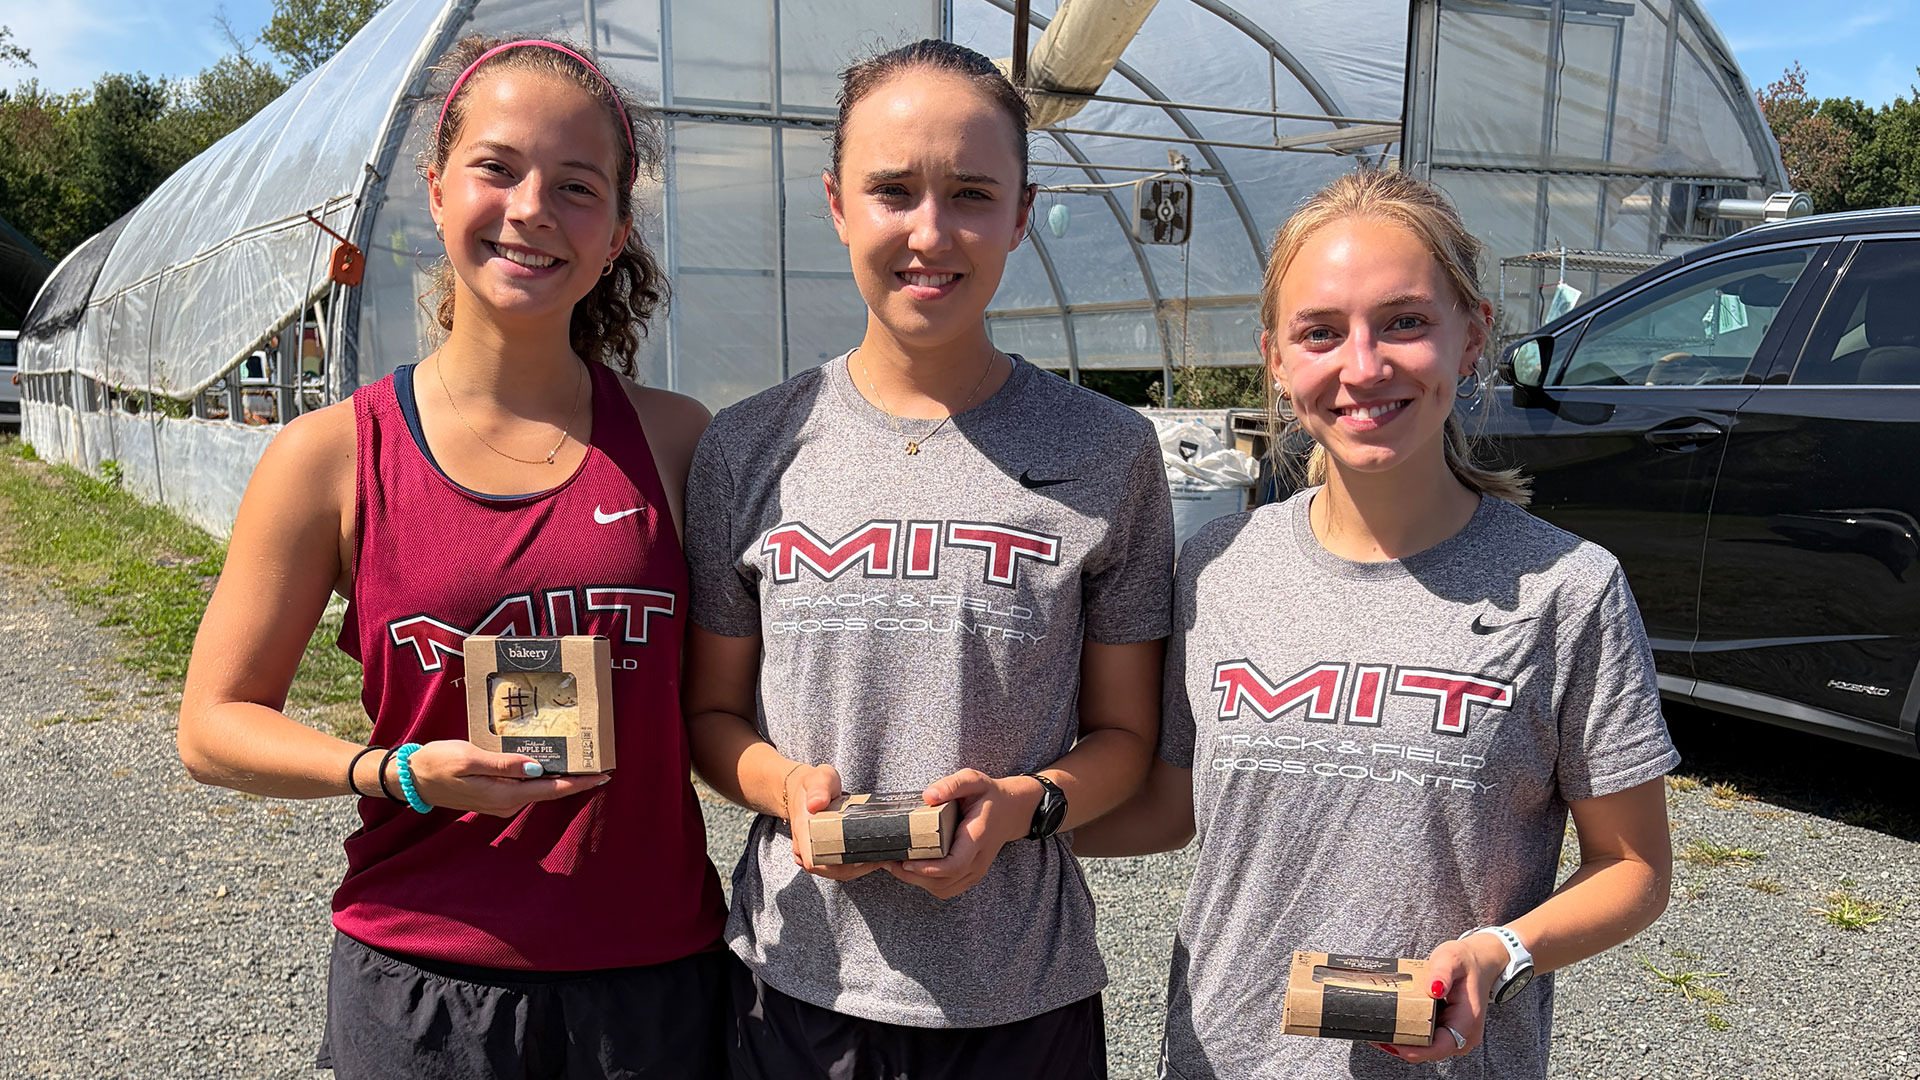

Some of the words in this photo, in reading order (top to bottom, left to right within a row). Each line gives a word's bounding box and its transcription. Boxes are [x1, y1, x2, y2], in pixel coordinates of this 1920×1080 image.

[760, 519, 1062, 589] MIT
[776, 593, 889, 611] TRACK
[896, 594, 923, 608] &
[930, 595, 1033, 620] FIELD
[387, 585, 676, 673] MIT
[771, 618, 868, 635] CROSS
[874, 618, 1047, 646] COUNTRY
[508, 647, 549, 660] bakery
[1211, 657, 1516, 738] MIT
[1827, 679, 1890, 696] HYBRID
[1218, 734, 1329, 752] TRACK
[1337, 740, 1365, 755] &
[1372, 743, 1486, 770] FIELD
[1212, 758, 1308, 775] CROSS
[1312, 762, 1500, 795] COUNTRY
